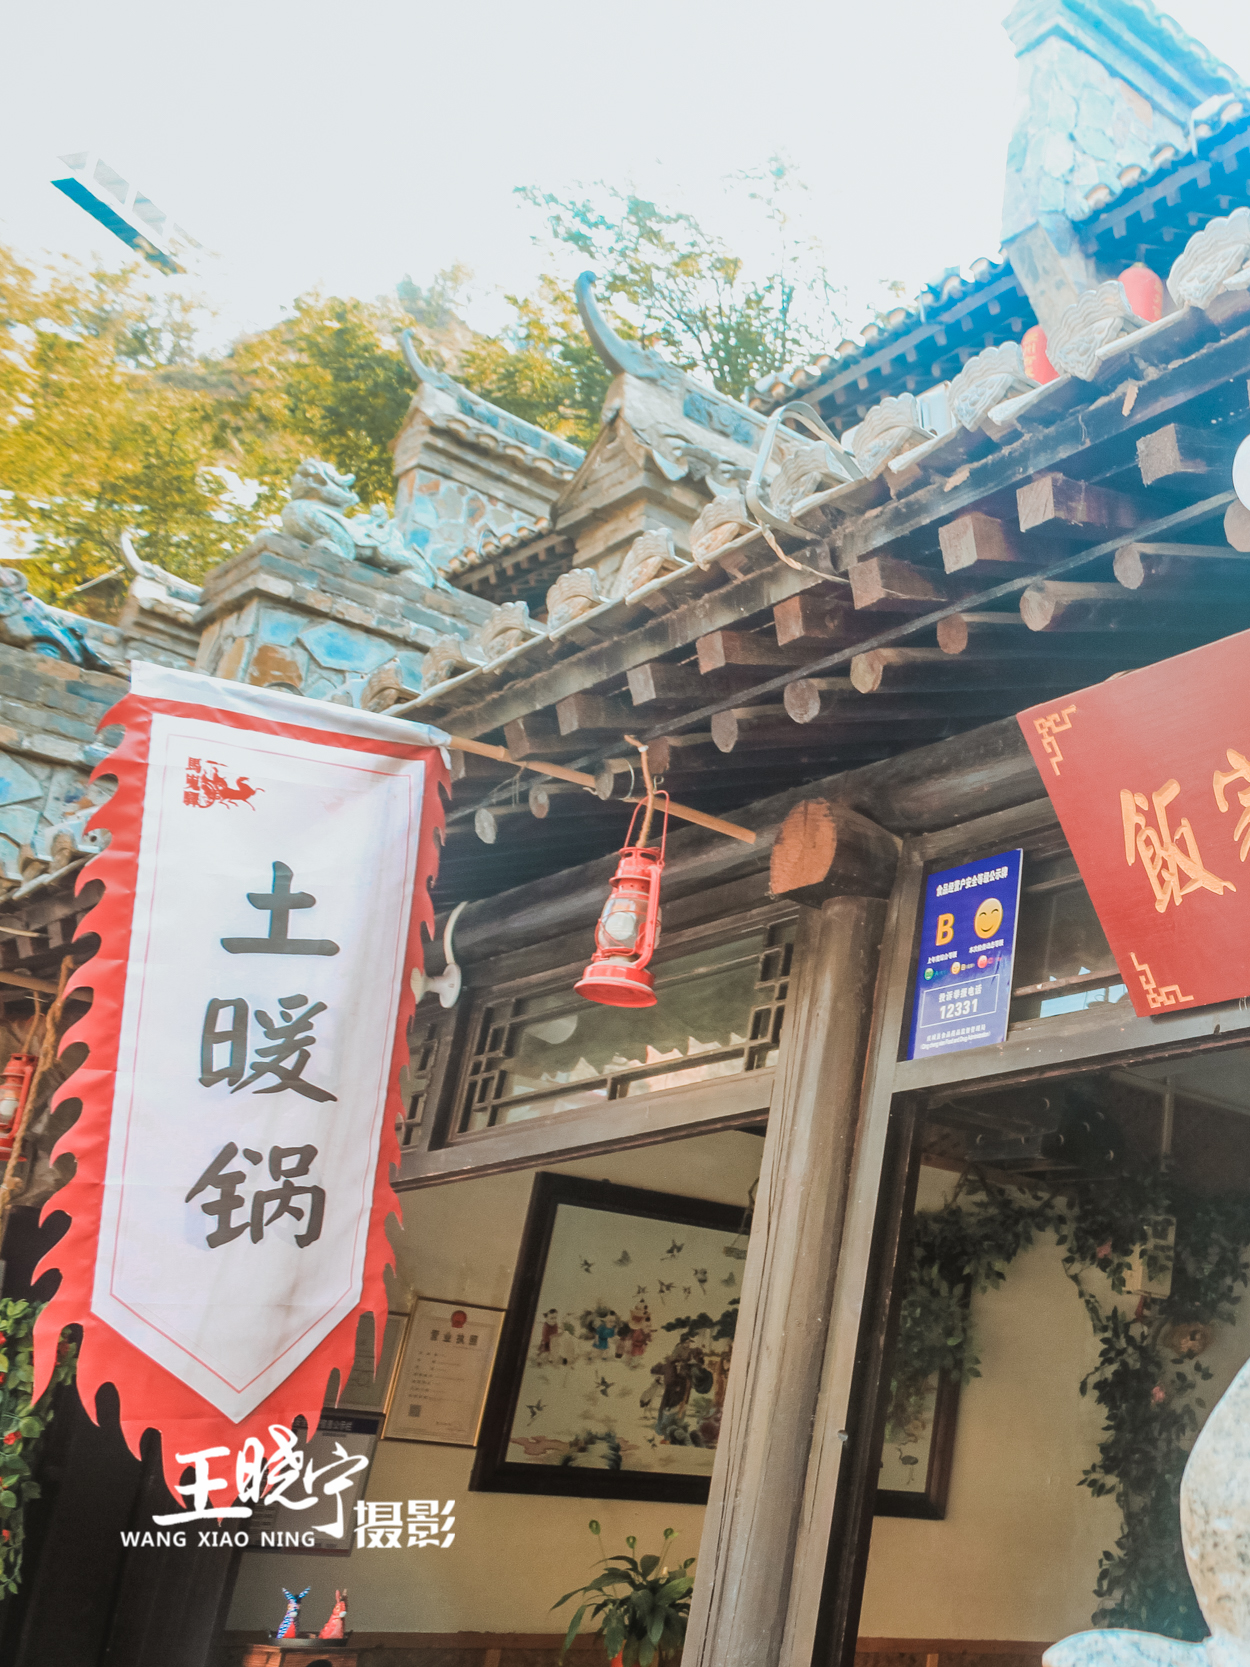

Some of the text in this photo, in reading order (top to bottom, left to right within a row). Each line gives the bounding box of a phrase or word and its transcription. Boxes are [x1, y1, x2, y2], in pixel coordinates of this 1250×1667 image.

[935, 912, 955, 947] B
[940, 998, 979, 1020] 12331
[185, 859, 341, 1249] 土暖锅
